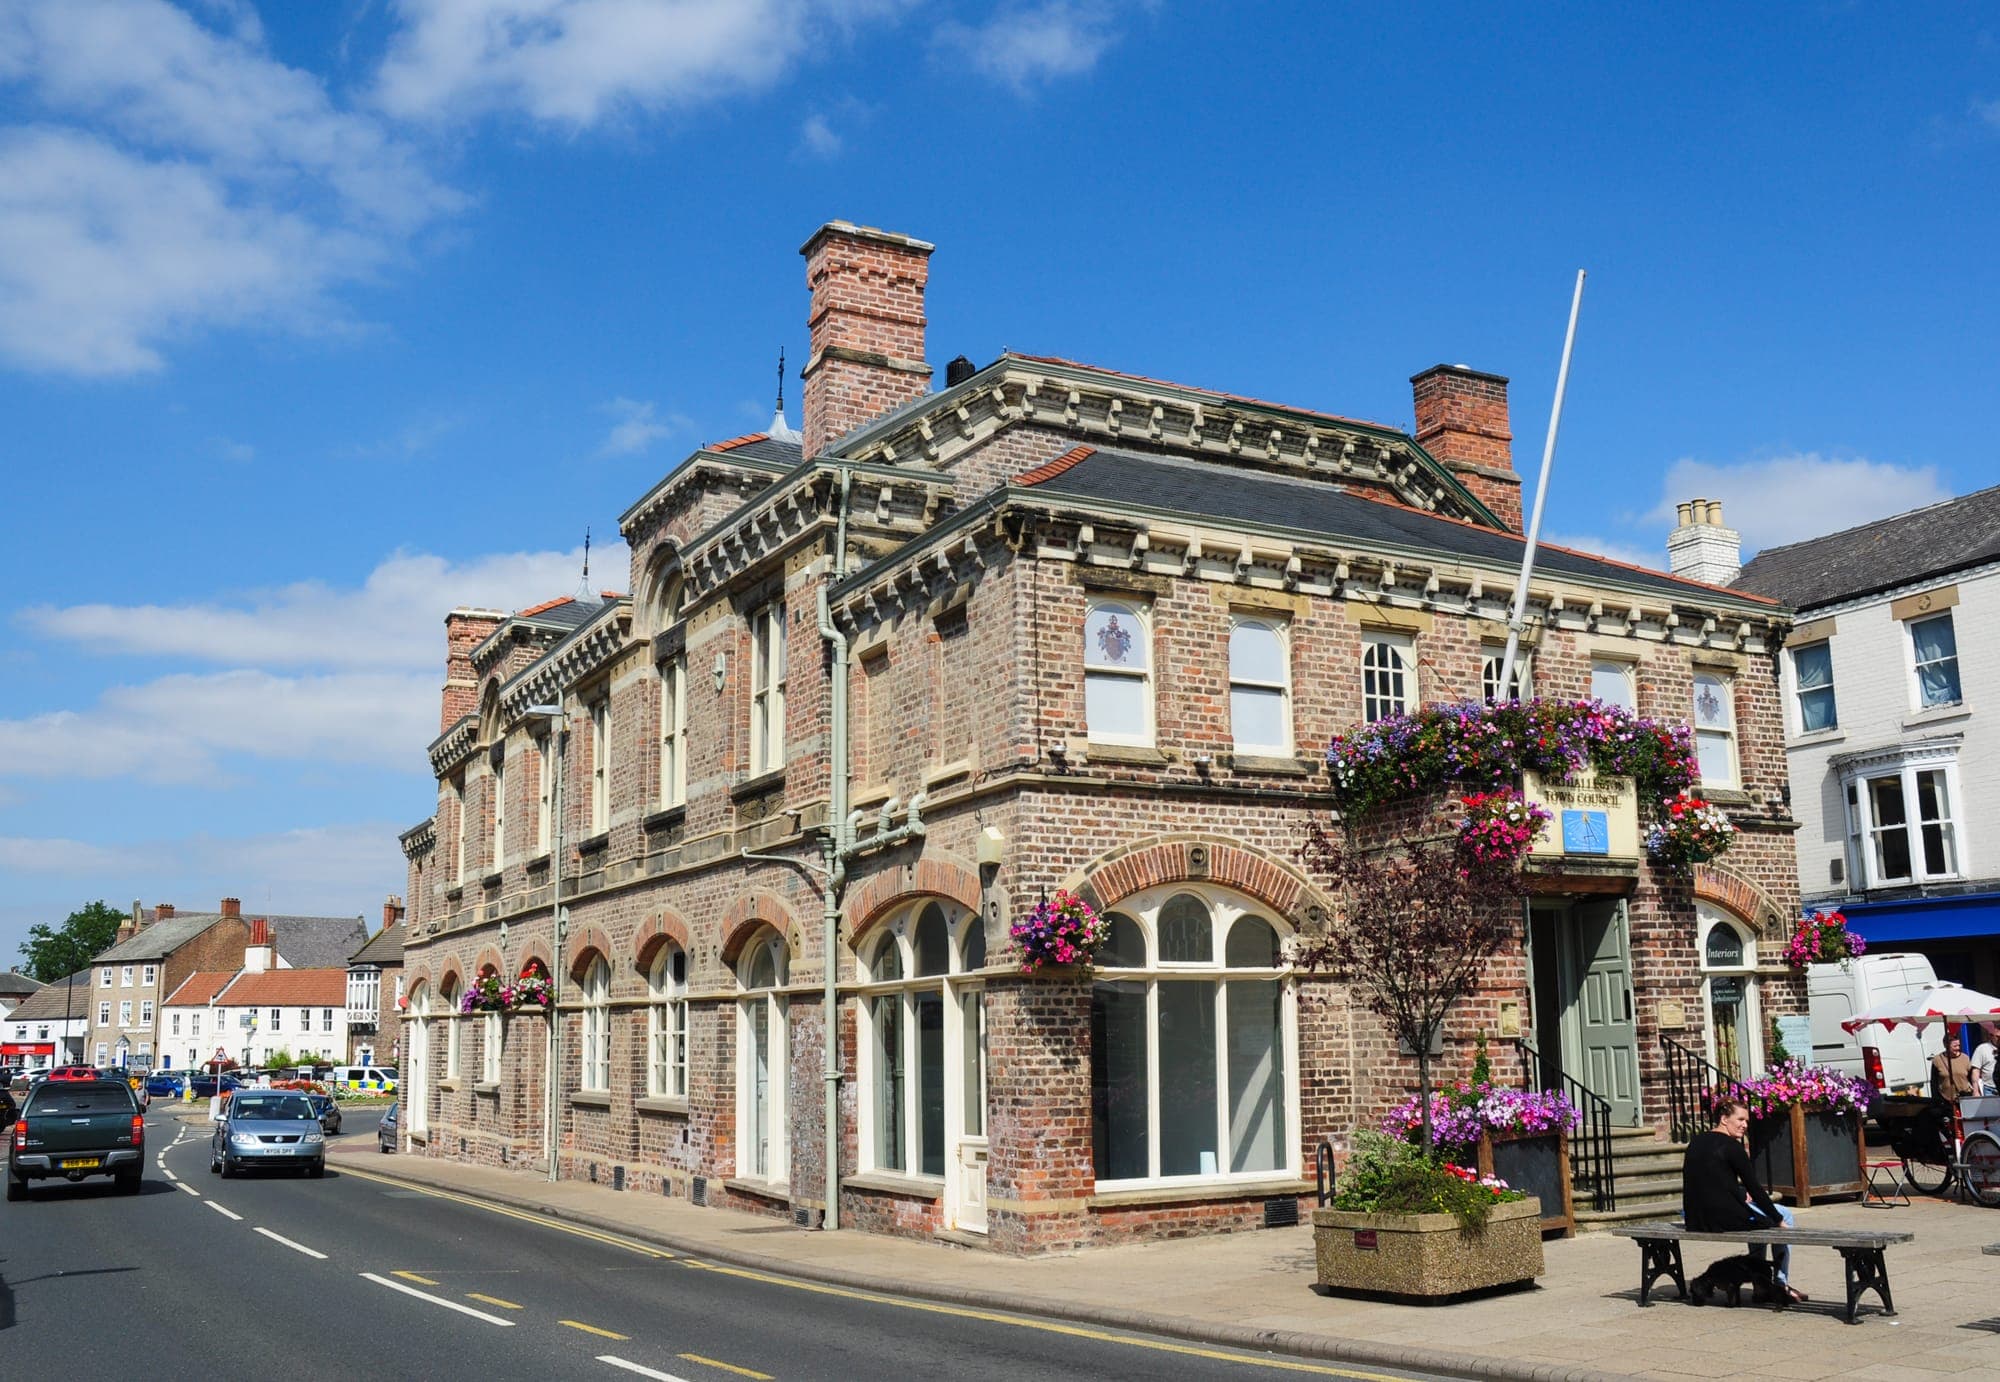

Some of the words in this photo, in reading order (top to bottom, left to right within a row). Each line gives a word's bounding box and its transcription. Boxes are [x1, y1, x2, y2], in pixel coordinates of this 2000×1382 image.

[1544, 791, 1574, 804] TOWN
[1577, 792, 1619, 806] COUNCIL
[1707, 948, 1739, 959] Interiors
